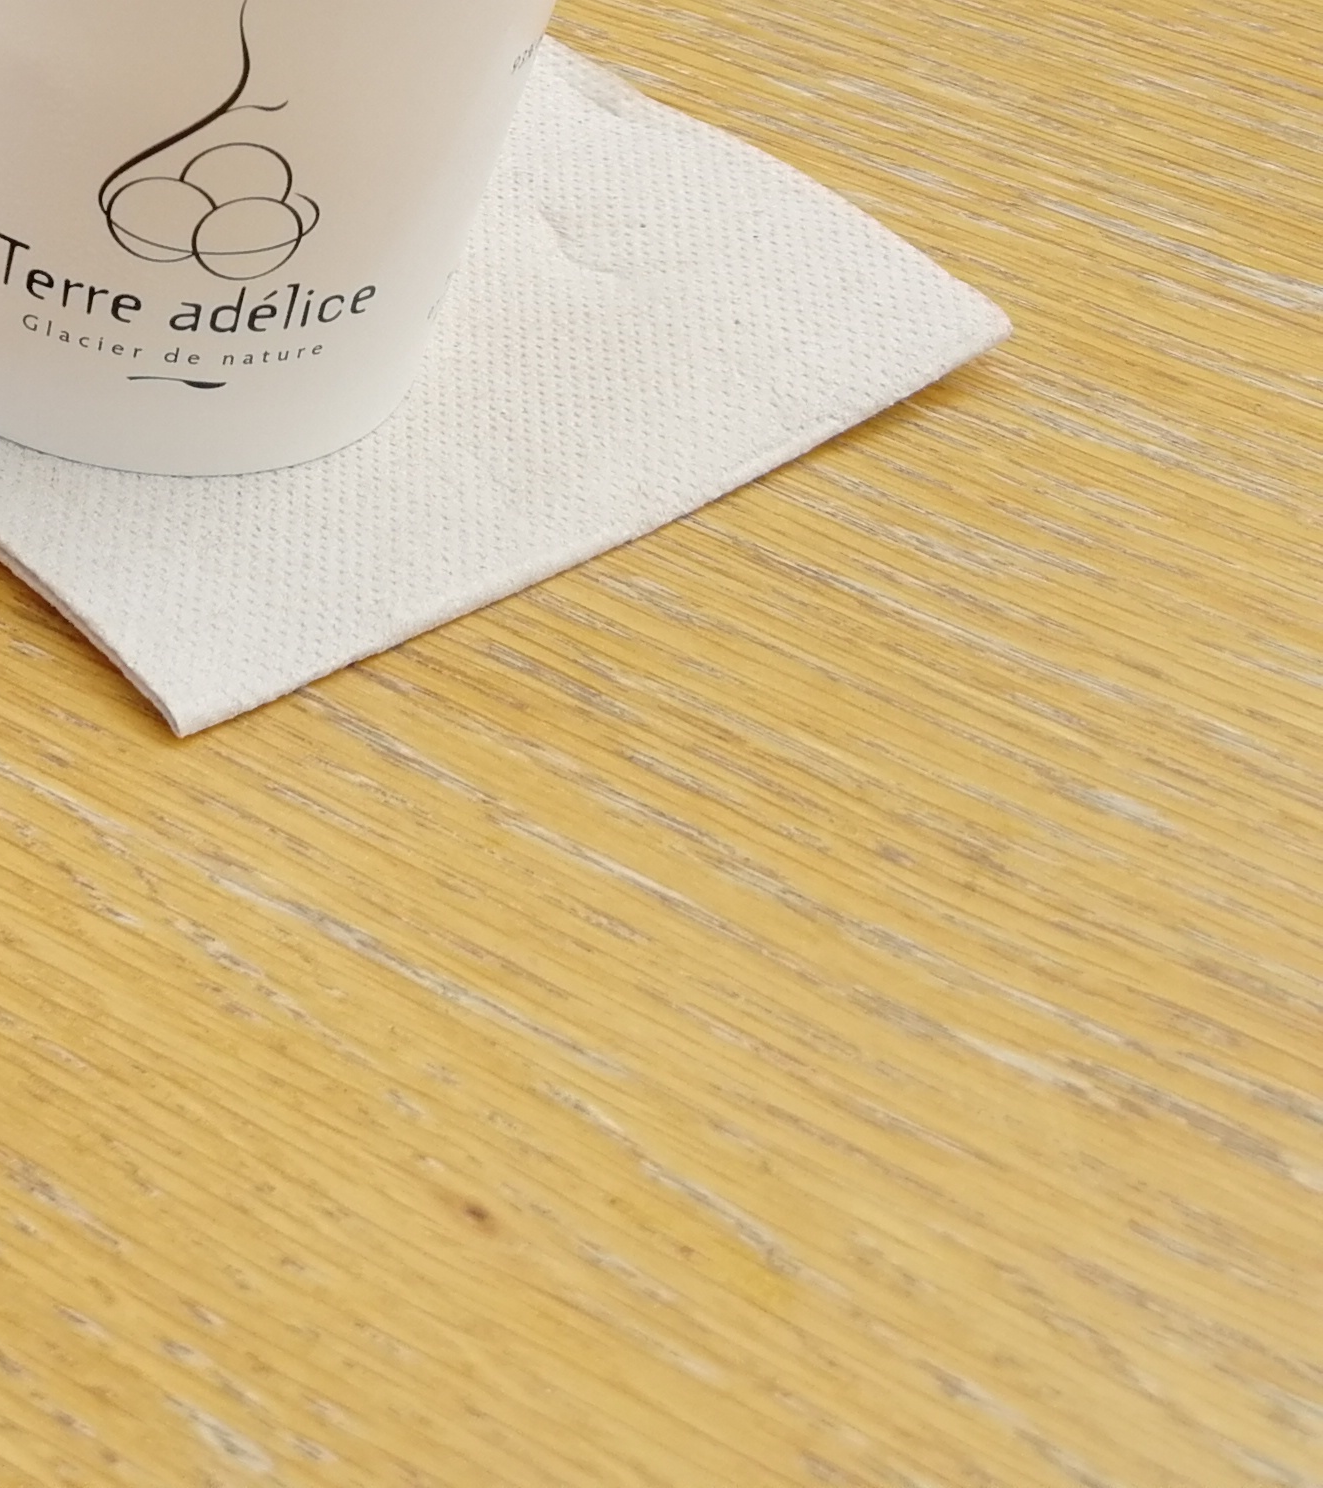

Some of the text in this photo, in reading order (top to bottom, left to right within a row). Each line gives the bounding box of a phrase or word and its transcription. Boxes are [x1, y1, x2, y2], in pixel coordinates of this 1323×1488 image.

[168, 282, 377, 334] adélice
[21, 313, 324, 366] Glacier de nature
